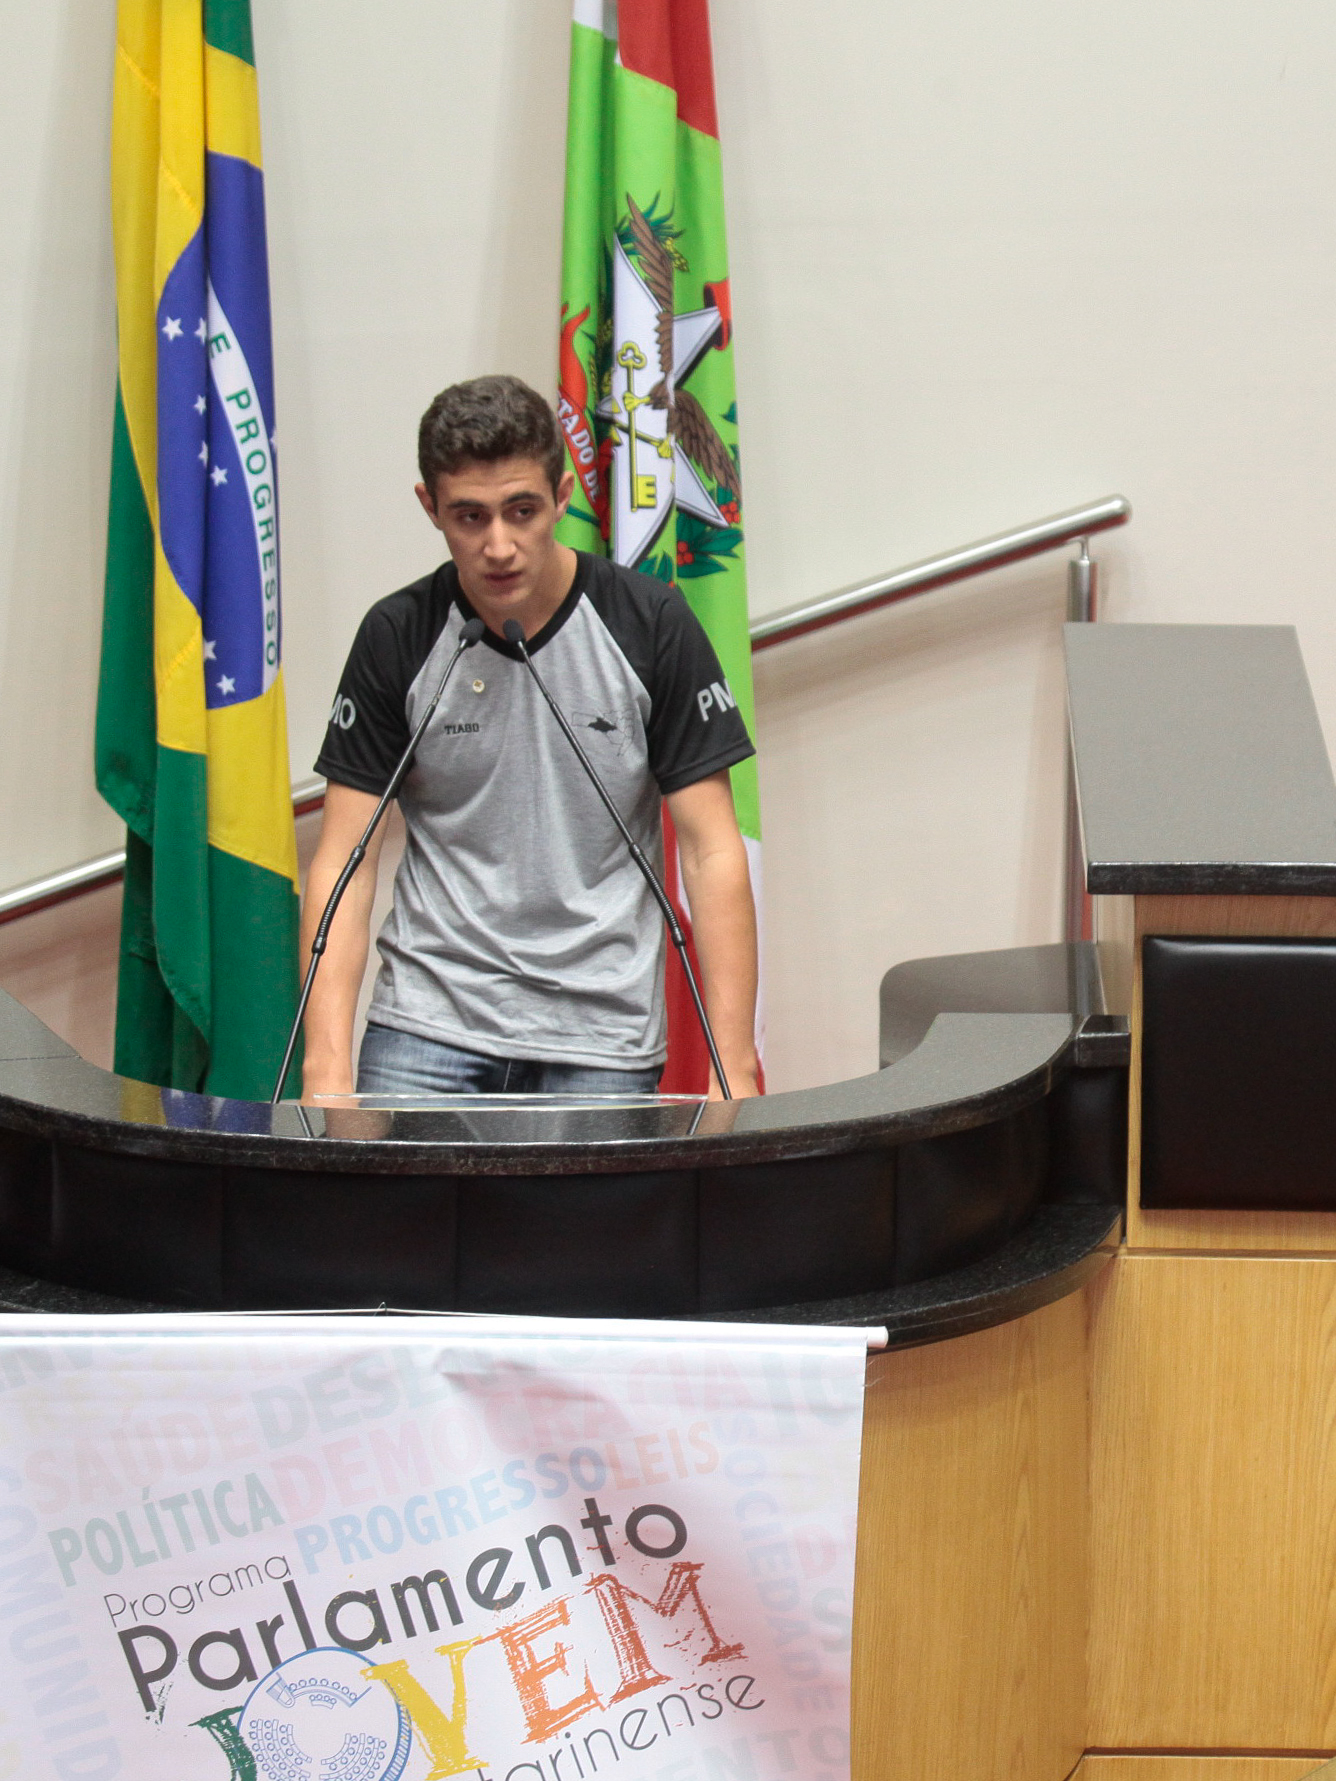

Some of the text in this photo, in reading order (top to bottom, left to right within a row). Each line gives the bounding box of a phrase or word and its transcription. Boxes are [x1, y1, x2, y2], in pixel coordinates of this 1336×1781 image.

[226, 388, 278, 666] PROGRESSO
[24, 1389, 258, 1514] SAÚDE
[295, 1446, 607, 1575] PROGRESSO
[604, 1421, 720, 1491] LEIS
[47, 1472, 285, 1587] POLÍTICA
[103, 1550, 292, 1628] Programa
[116, 1497, 689, 1712] Parlamento
